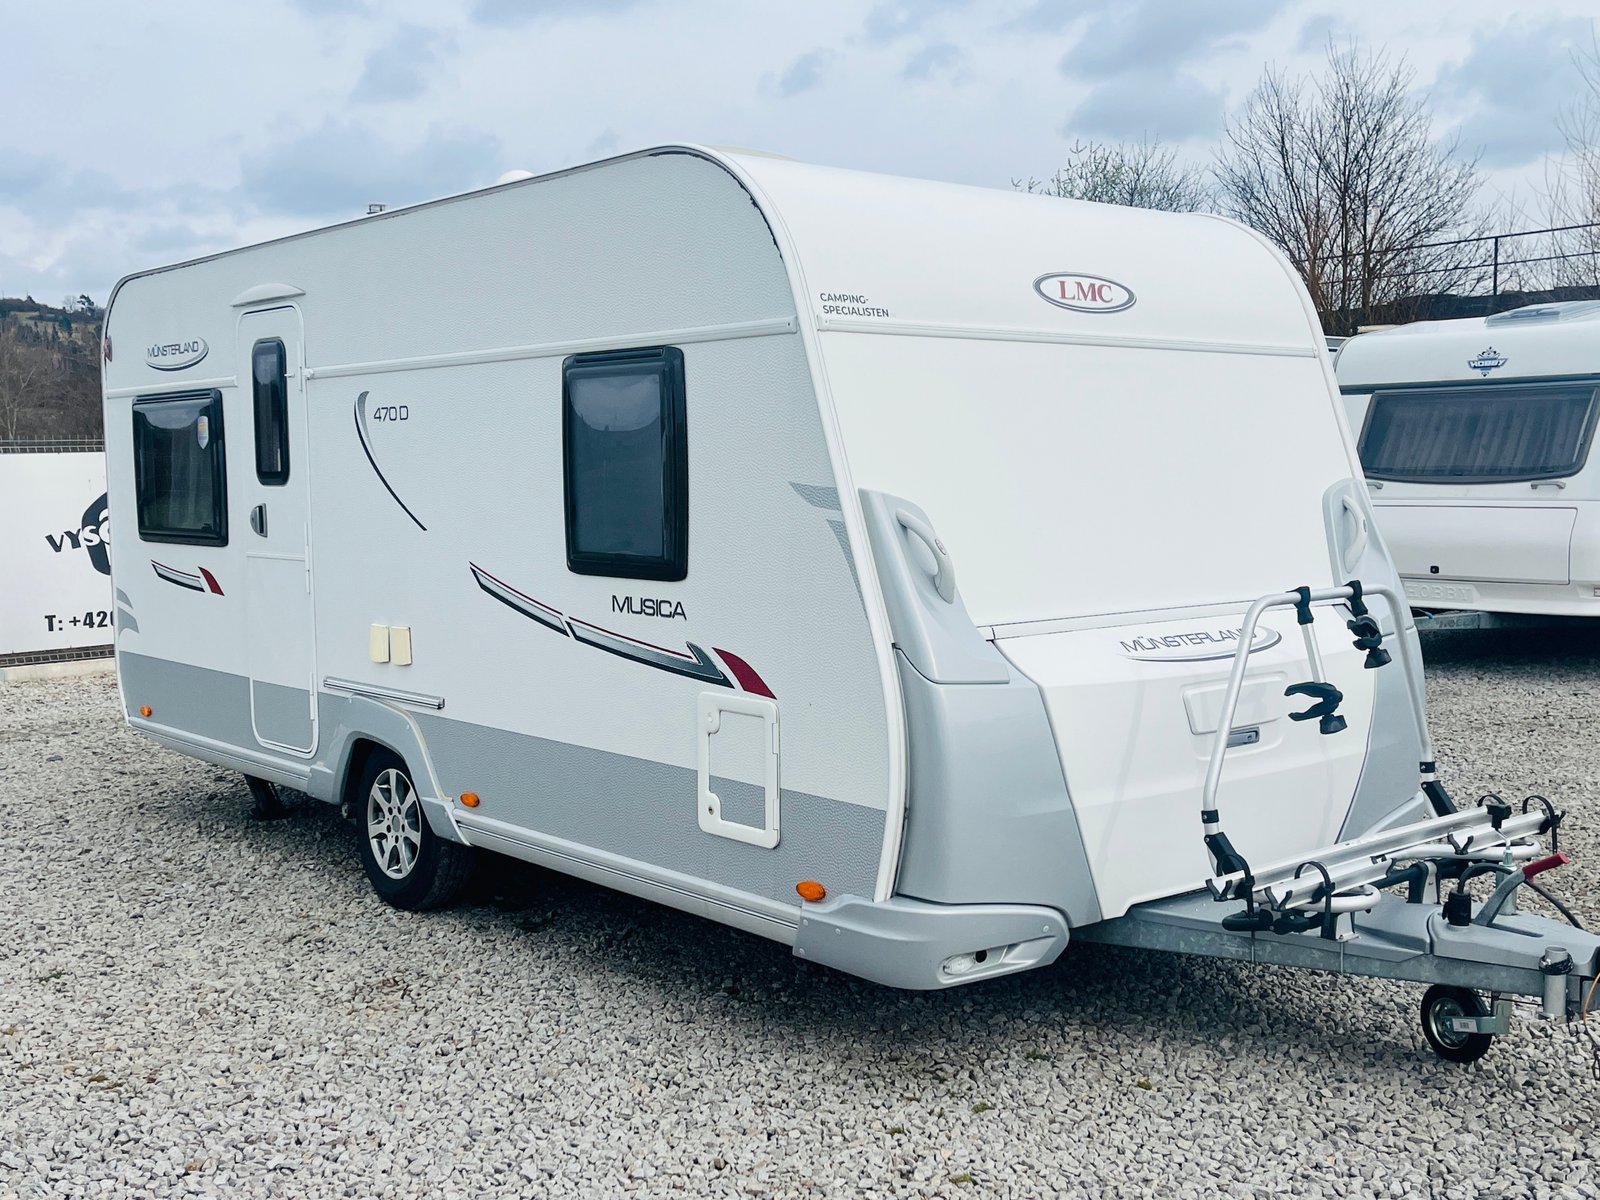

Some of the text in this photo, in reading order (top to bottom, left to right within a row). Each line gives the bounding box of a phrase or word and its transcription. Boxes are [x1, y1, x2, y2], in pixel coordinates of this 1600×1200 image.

[820, 293, 869, 304] CAMPING-
[1058, 280, 1113, 304] LMC
[822, 305, 889, 317] SPECIALISTEN
[147, 341, 199, 358] MÜNSTERLAND
[1469, 359, 1506, 367] HOBBY
[612, 594, 687, 621] MUSICA
[44, 610, 114, 632] T: +42
[1119, 628, 1258, 653] MÜNSTERLAN
